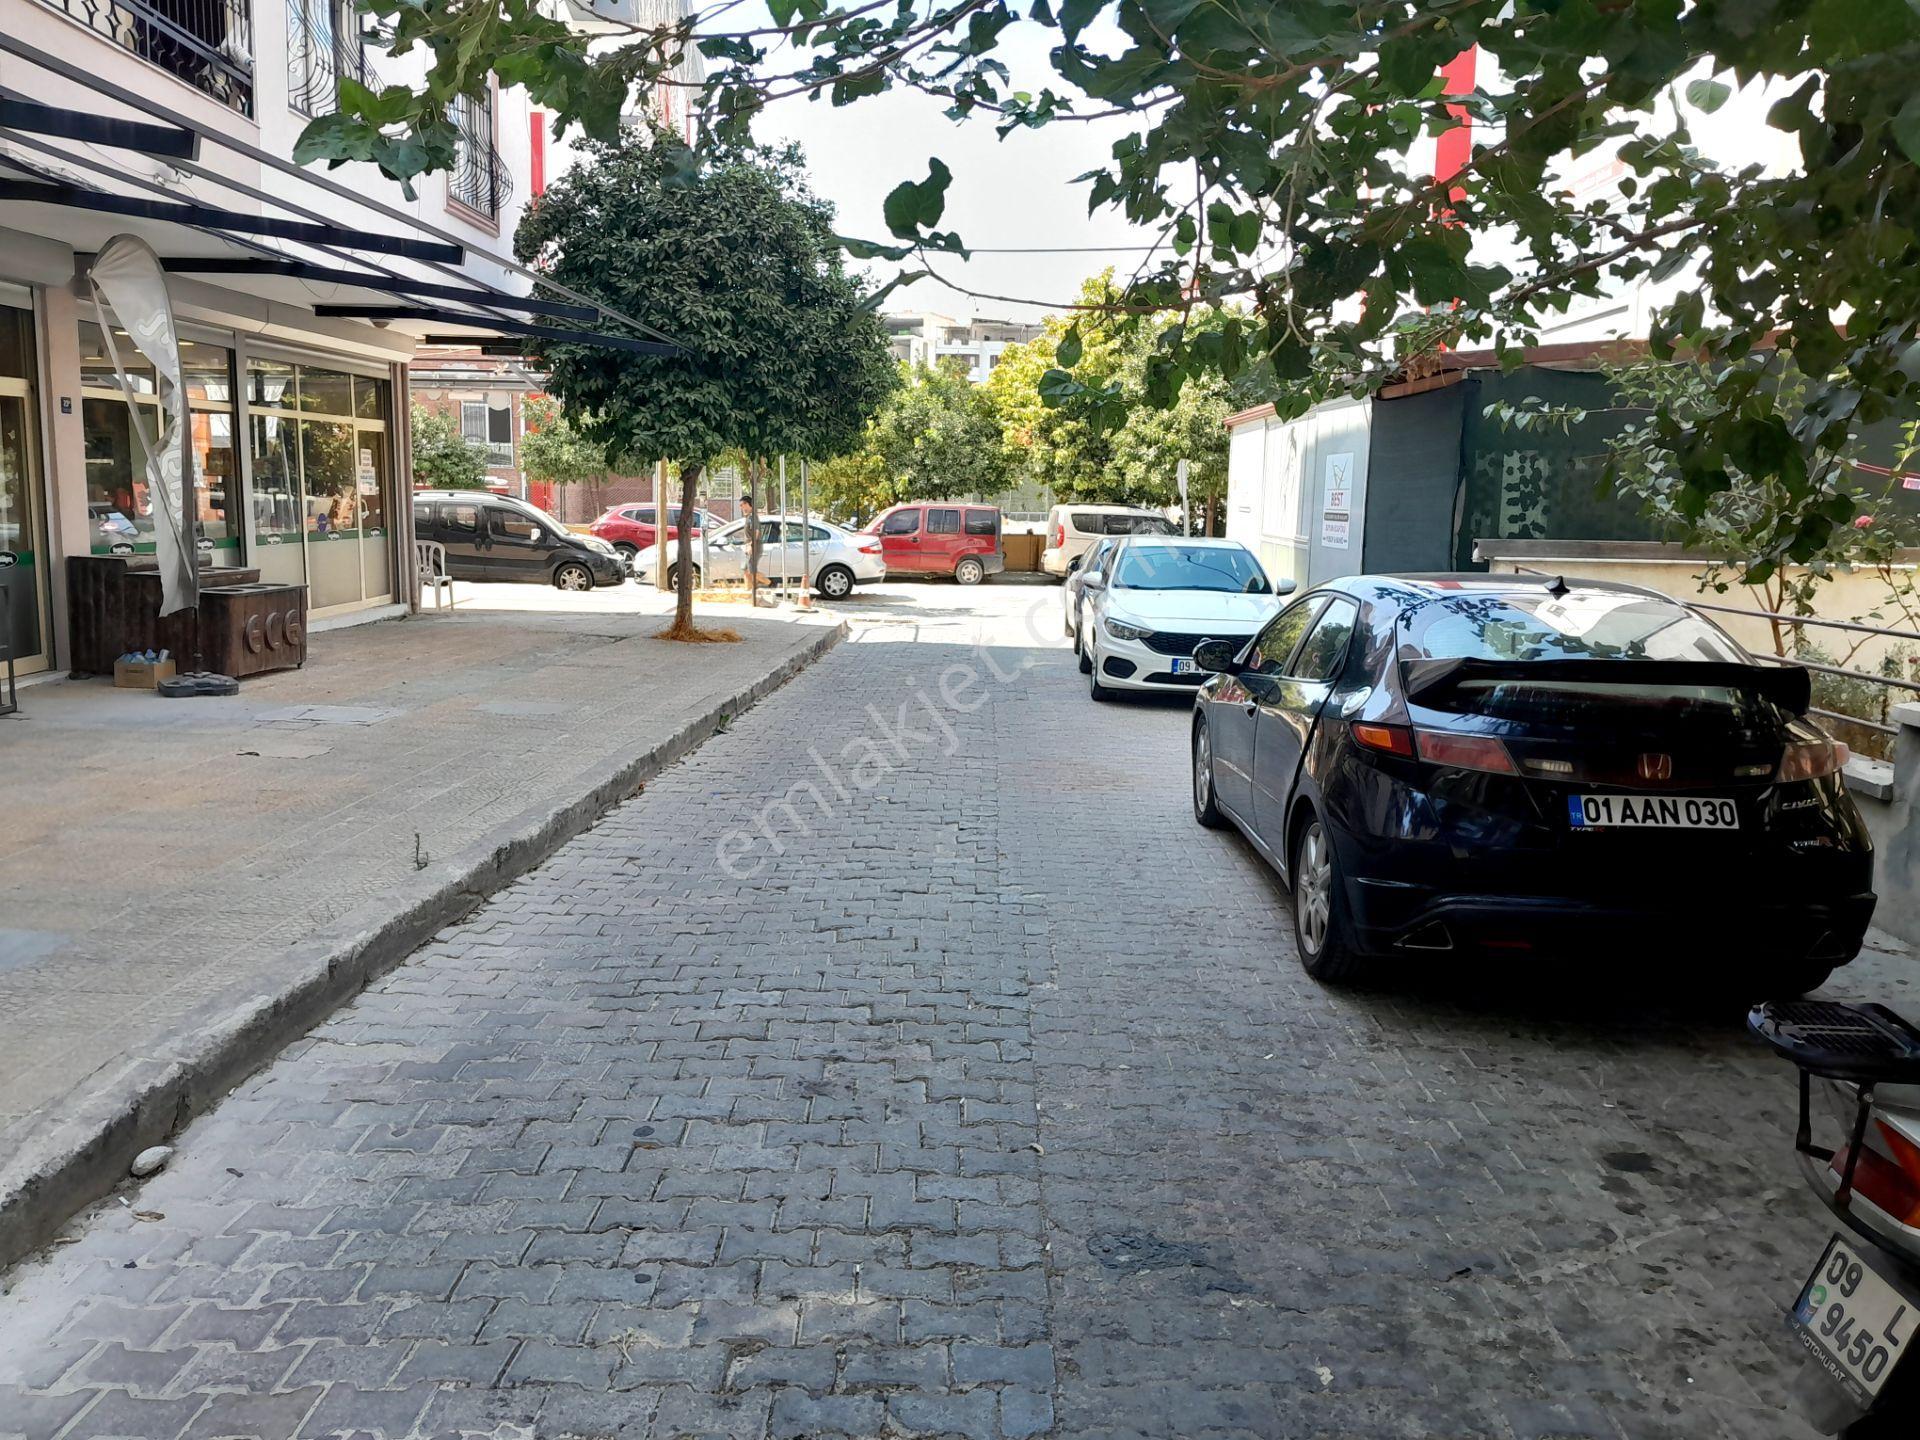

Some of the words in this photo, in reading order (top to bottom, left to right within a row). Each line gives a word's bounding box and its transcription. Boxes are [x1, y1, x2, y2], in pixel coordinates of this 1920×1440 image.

[1178, 661, 1191, 671] 09
[1583, 797, 1613, 823] 01
[1620, 798, 1681, 825] AAN
[1685, 800, 1736, 827] 030
[1826, 1250, 1864, 1298] 09
[1883, 1304, 1907, 1347] L
[1800, 1331, 1847, 1382] MOTOMURAT
[1819, 1302, 1889, 1383] 9450
